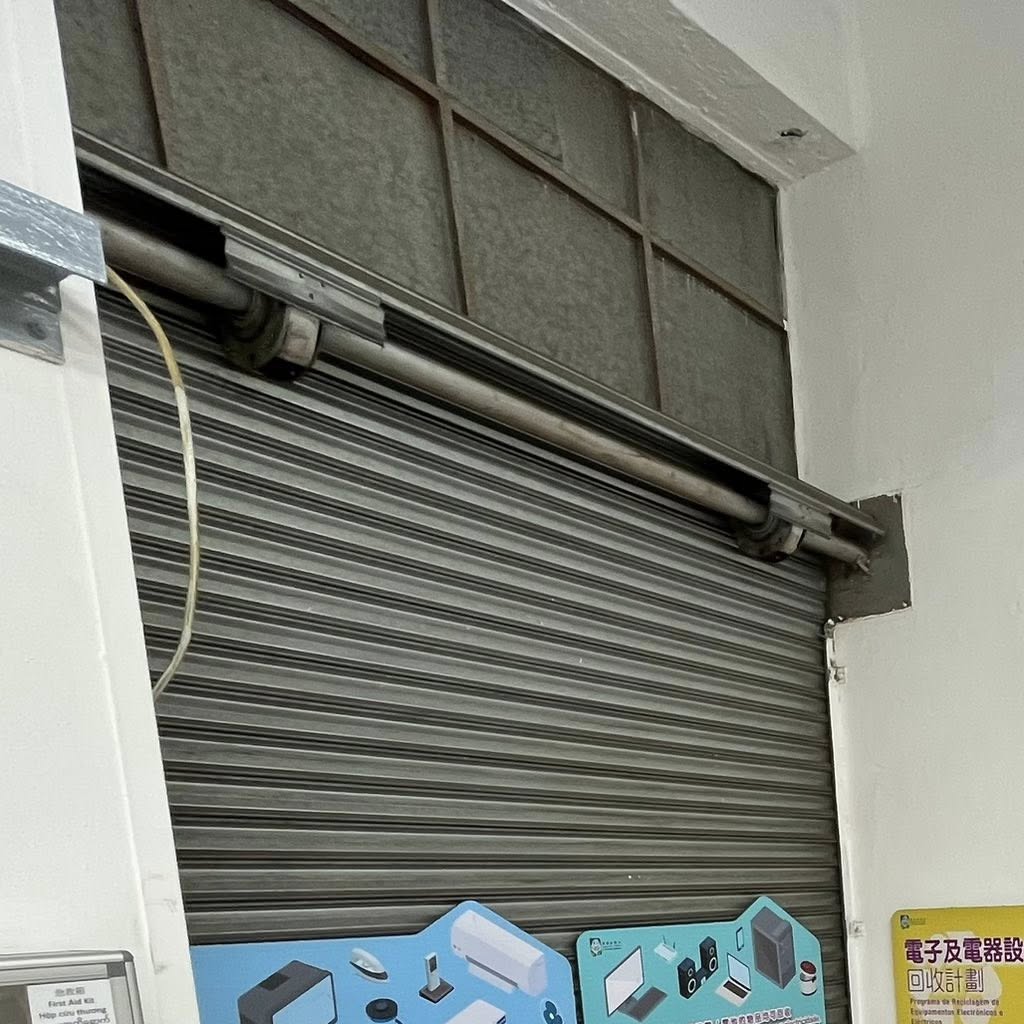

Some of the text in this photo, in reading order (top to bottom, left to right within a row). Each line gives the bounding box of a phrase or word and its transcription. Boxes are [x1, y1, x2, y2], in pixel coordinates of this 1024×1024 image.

[907, 968, 984, 992] 回收計劃
[48, 1000, 66, 1008] First
[68, 998, 82, 1006] Aid
[910, 998, 940, 1007] Programa
[951, 998, 989, 1007] Reciclagem
